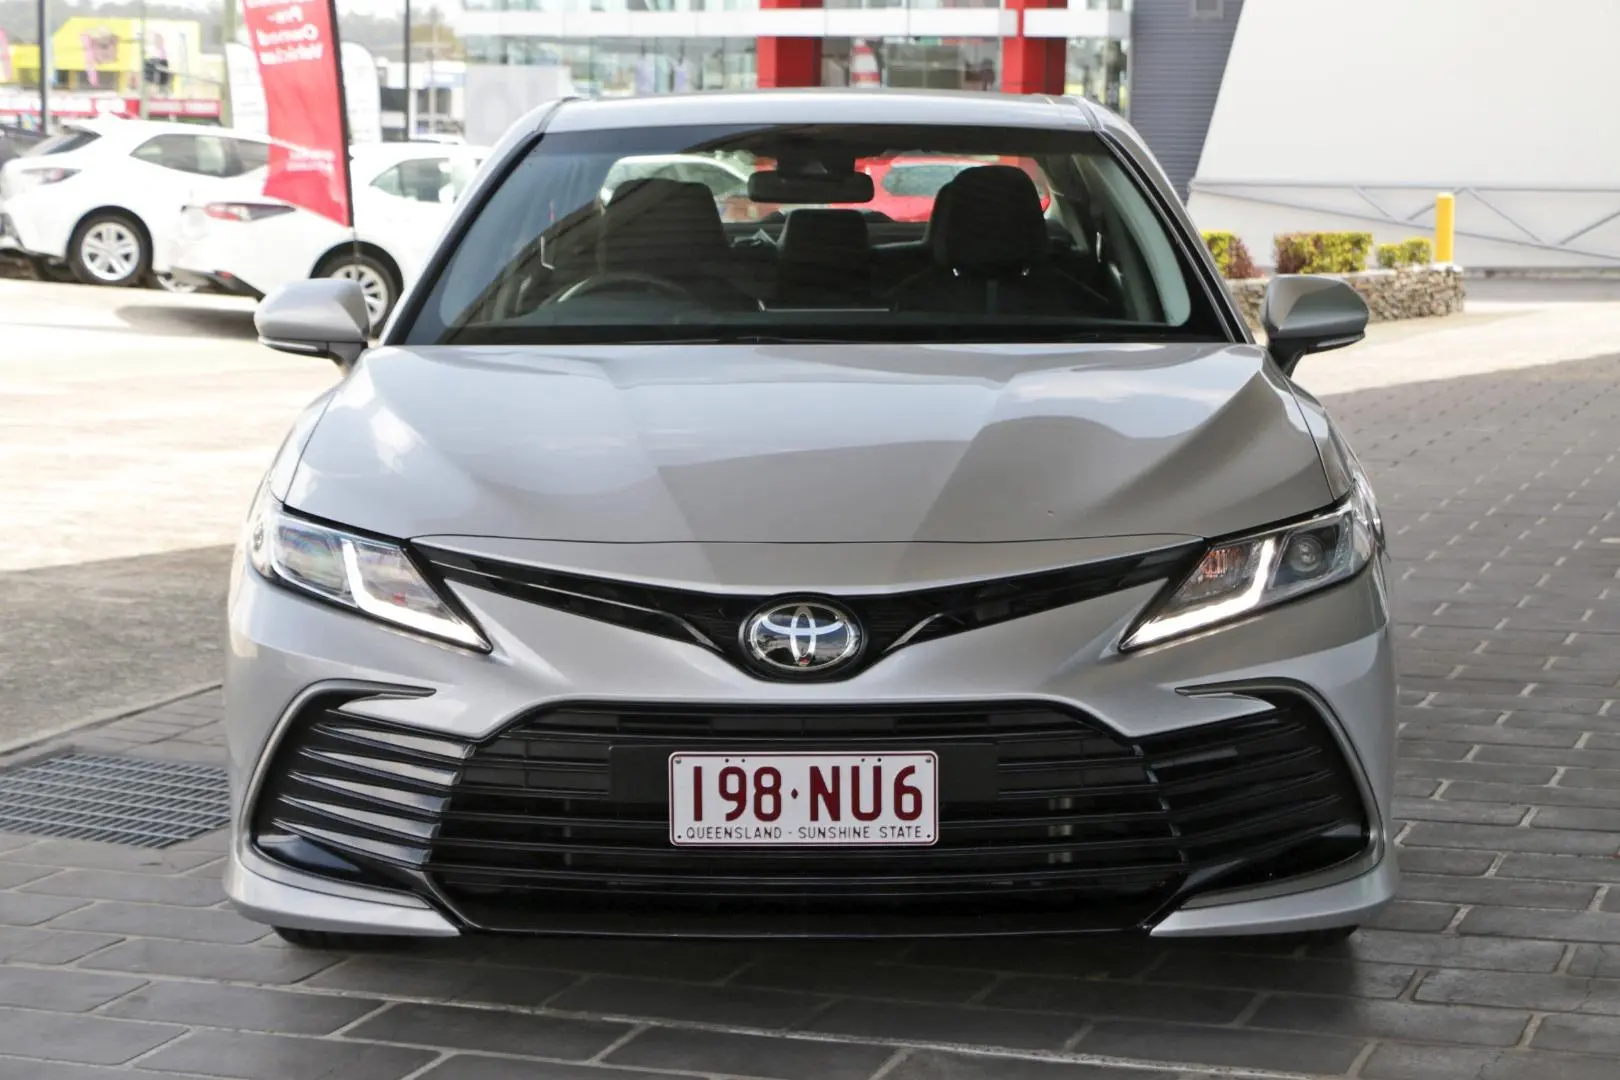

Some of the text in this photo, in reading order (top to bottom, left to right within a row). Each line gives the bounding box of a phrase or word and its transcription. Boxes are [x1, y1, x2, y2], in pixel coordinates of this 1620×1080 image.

[686, 826, 782, 839] QUEENSLAND
[797, 826, 871, 839] SUNSHINE
[879, 825, 922, 839] STATE
